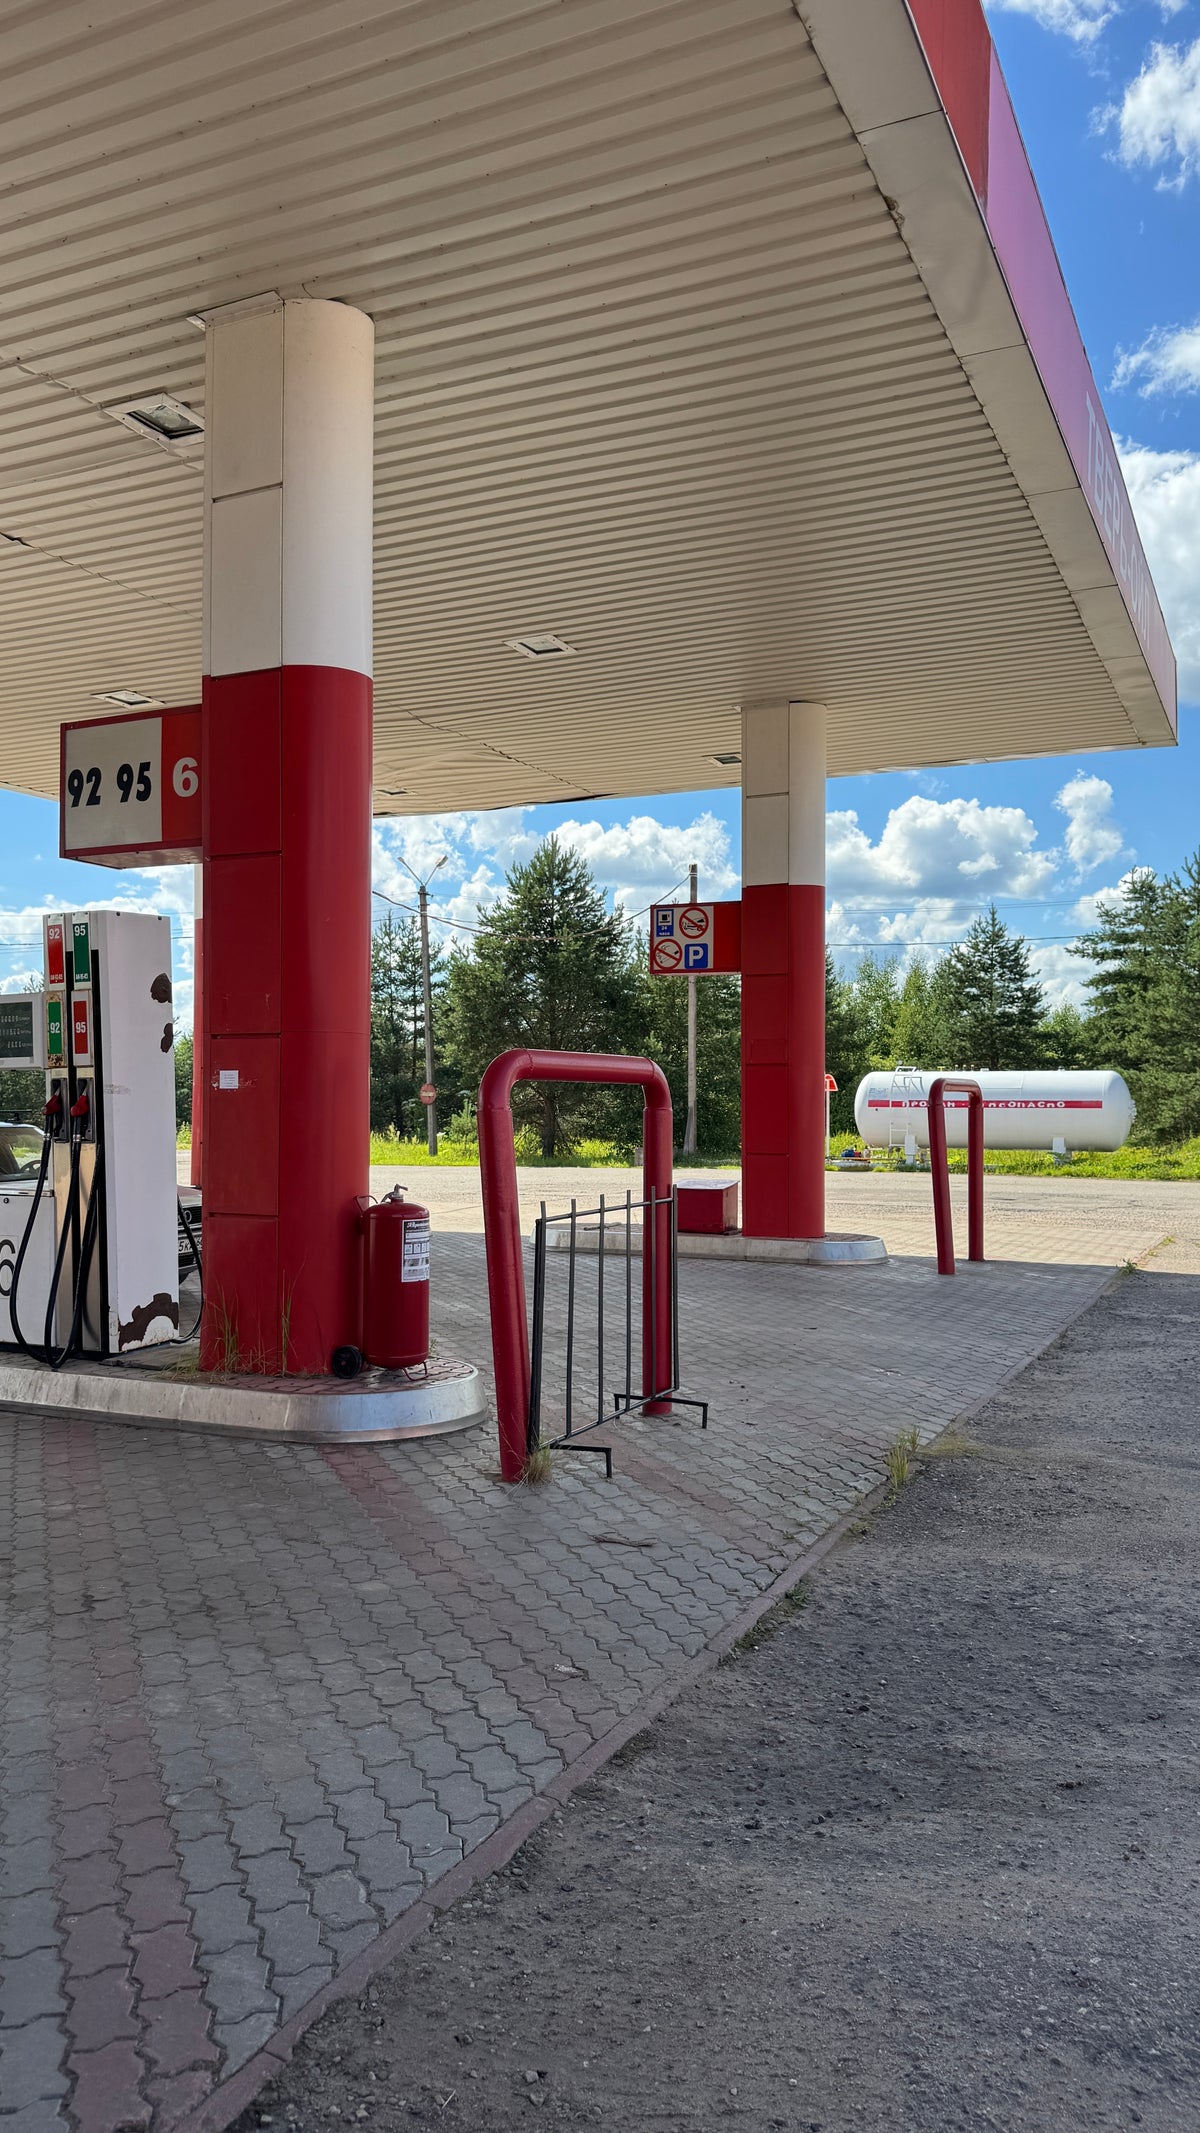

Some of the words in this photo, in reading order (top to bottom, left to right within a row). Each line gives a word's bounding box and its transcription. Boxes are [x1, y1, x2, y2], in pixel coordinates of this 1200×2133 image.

[172, 756, 199, 798] 6
[68, 767, 102, 808] 92
[116, 761, 152, 803] 95
[48, 928, 60, 940] 92
[74, 925, 86, 936] 95
[688, 946, 704, 967] P
[50, 1022, 61, 1034] 92
[75, 1021, 87, 1034] 95
